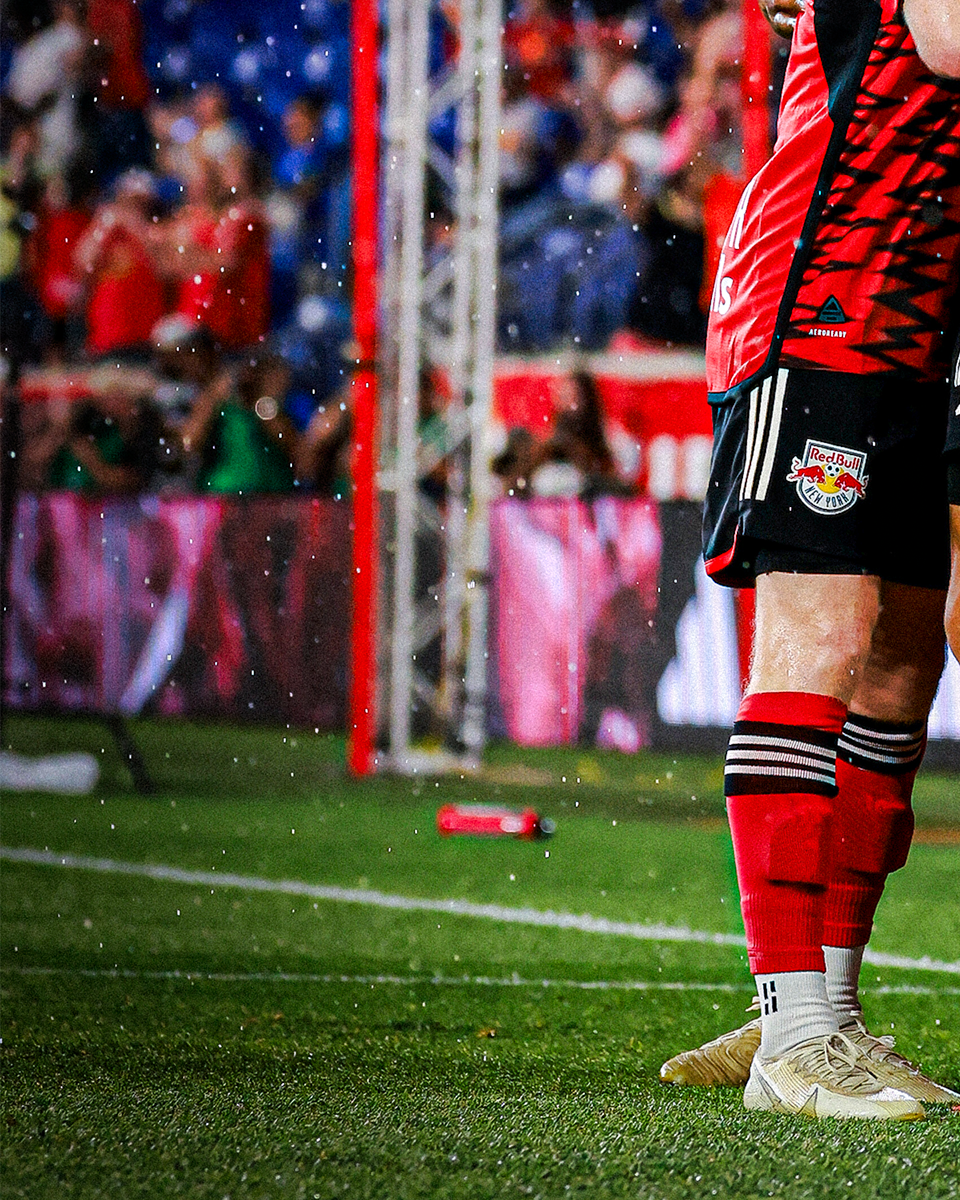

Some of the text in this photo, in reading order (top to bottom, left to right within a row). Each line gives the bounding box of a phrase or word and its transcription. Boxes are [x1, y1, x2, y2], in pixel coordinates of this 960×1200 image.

[810, 447, 861, 471] Red Bull
[804, 485, 850, 508] NEW YORK
